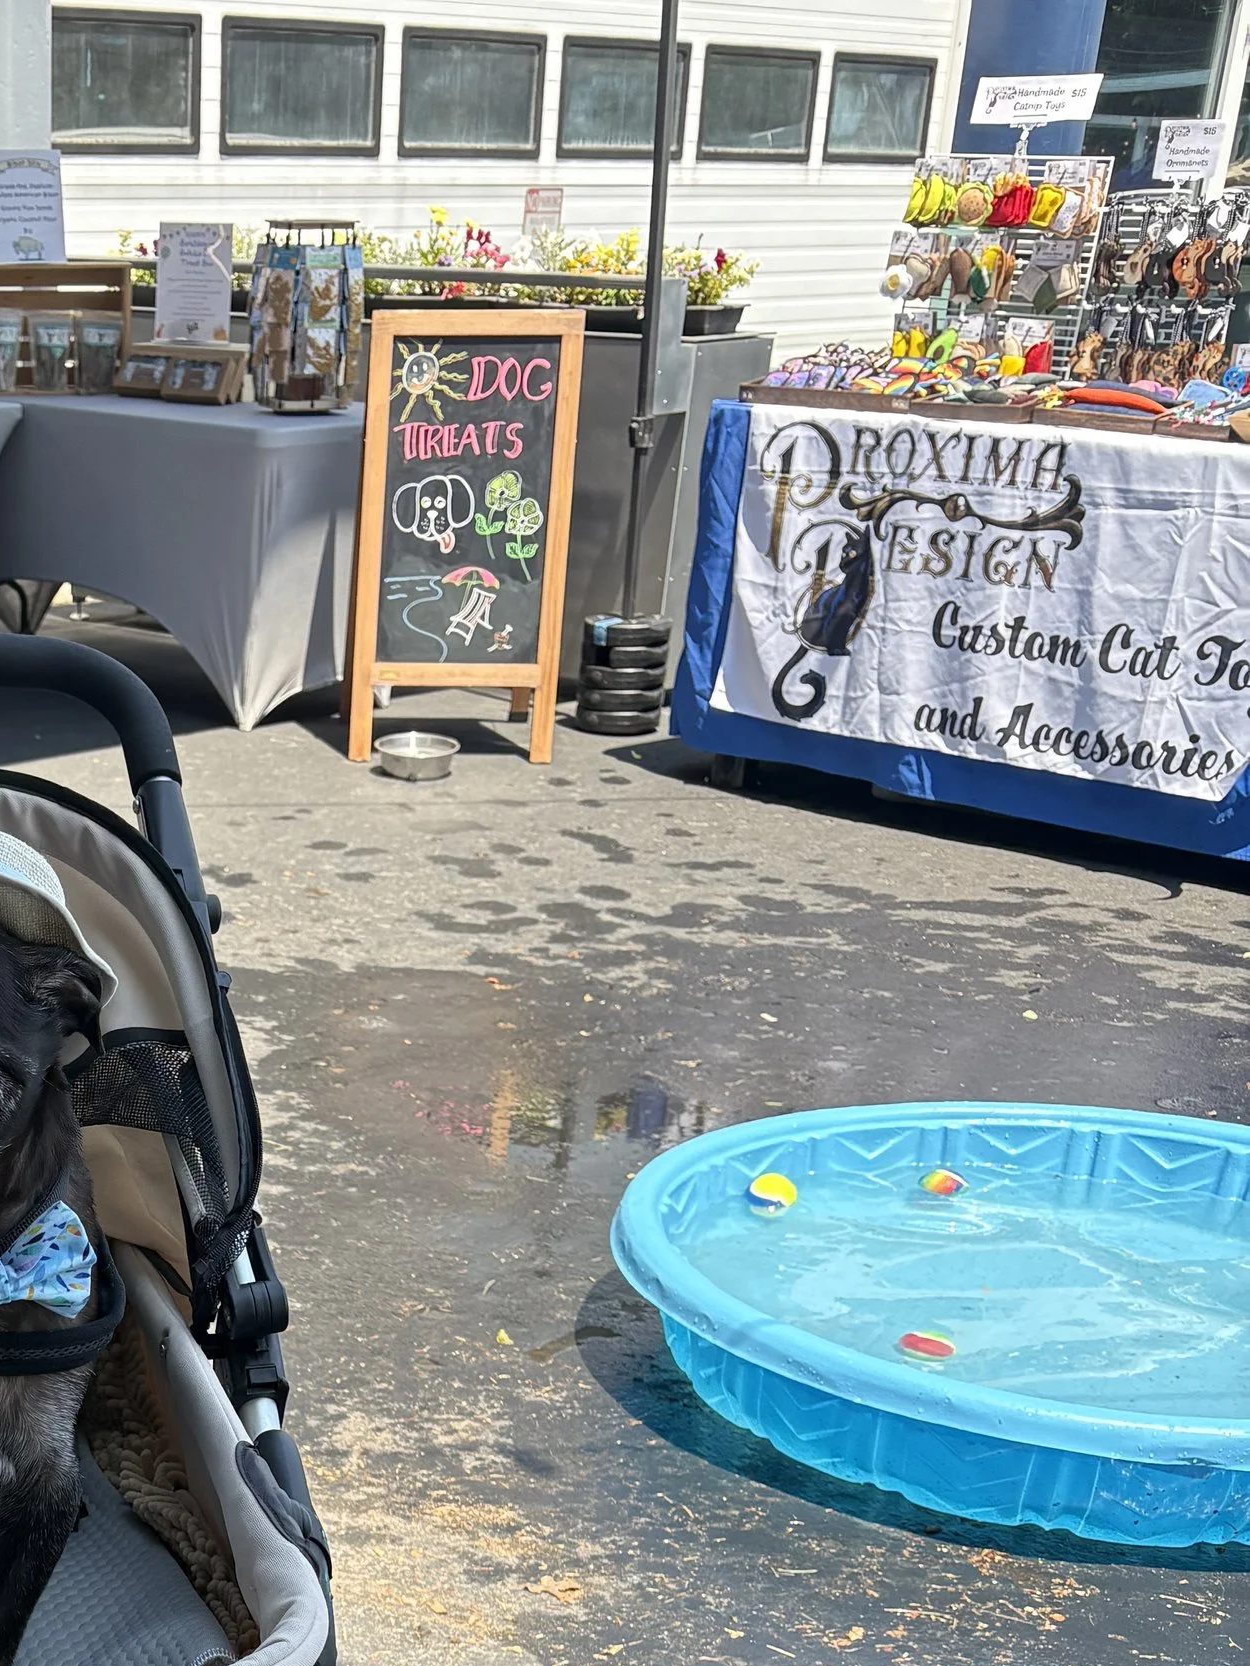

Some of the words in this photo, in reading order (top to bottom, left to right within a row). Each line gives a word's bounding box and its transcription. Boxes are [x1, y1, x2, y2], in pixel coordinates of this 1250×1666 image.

[1013, 101, 1043, 111] Catnip
[1045, 100, 1066, 111] Toys
[1016, 87, 1066, 98] Handmade
[1071, 87, 1087, 98] $15
[1168, 147, 1211, 156] Handmade
[1203, 126, 1217, 136] $15
[466, 355, 553, 401] DOG
[392, 420, 524, 461] TREATS
[759, 420, 1073, 574] PROXIMA
[931, 600, 1087, 668] Custom
[1099, 623, 1181, 680] Cat
[1193, 635, 1250, 718] To
[913, 696, 984, 742] and
[994, 702, 1235, 781] Accessories
